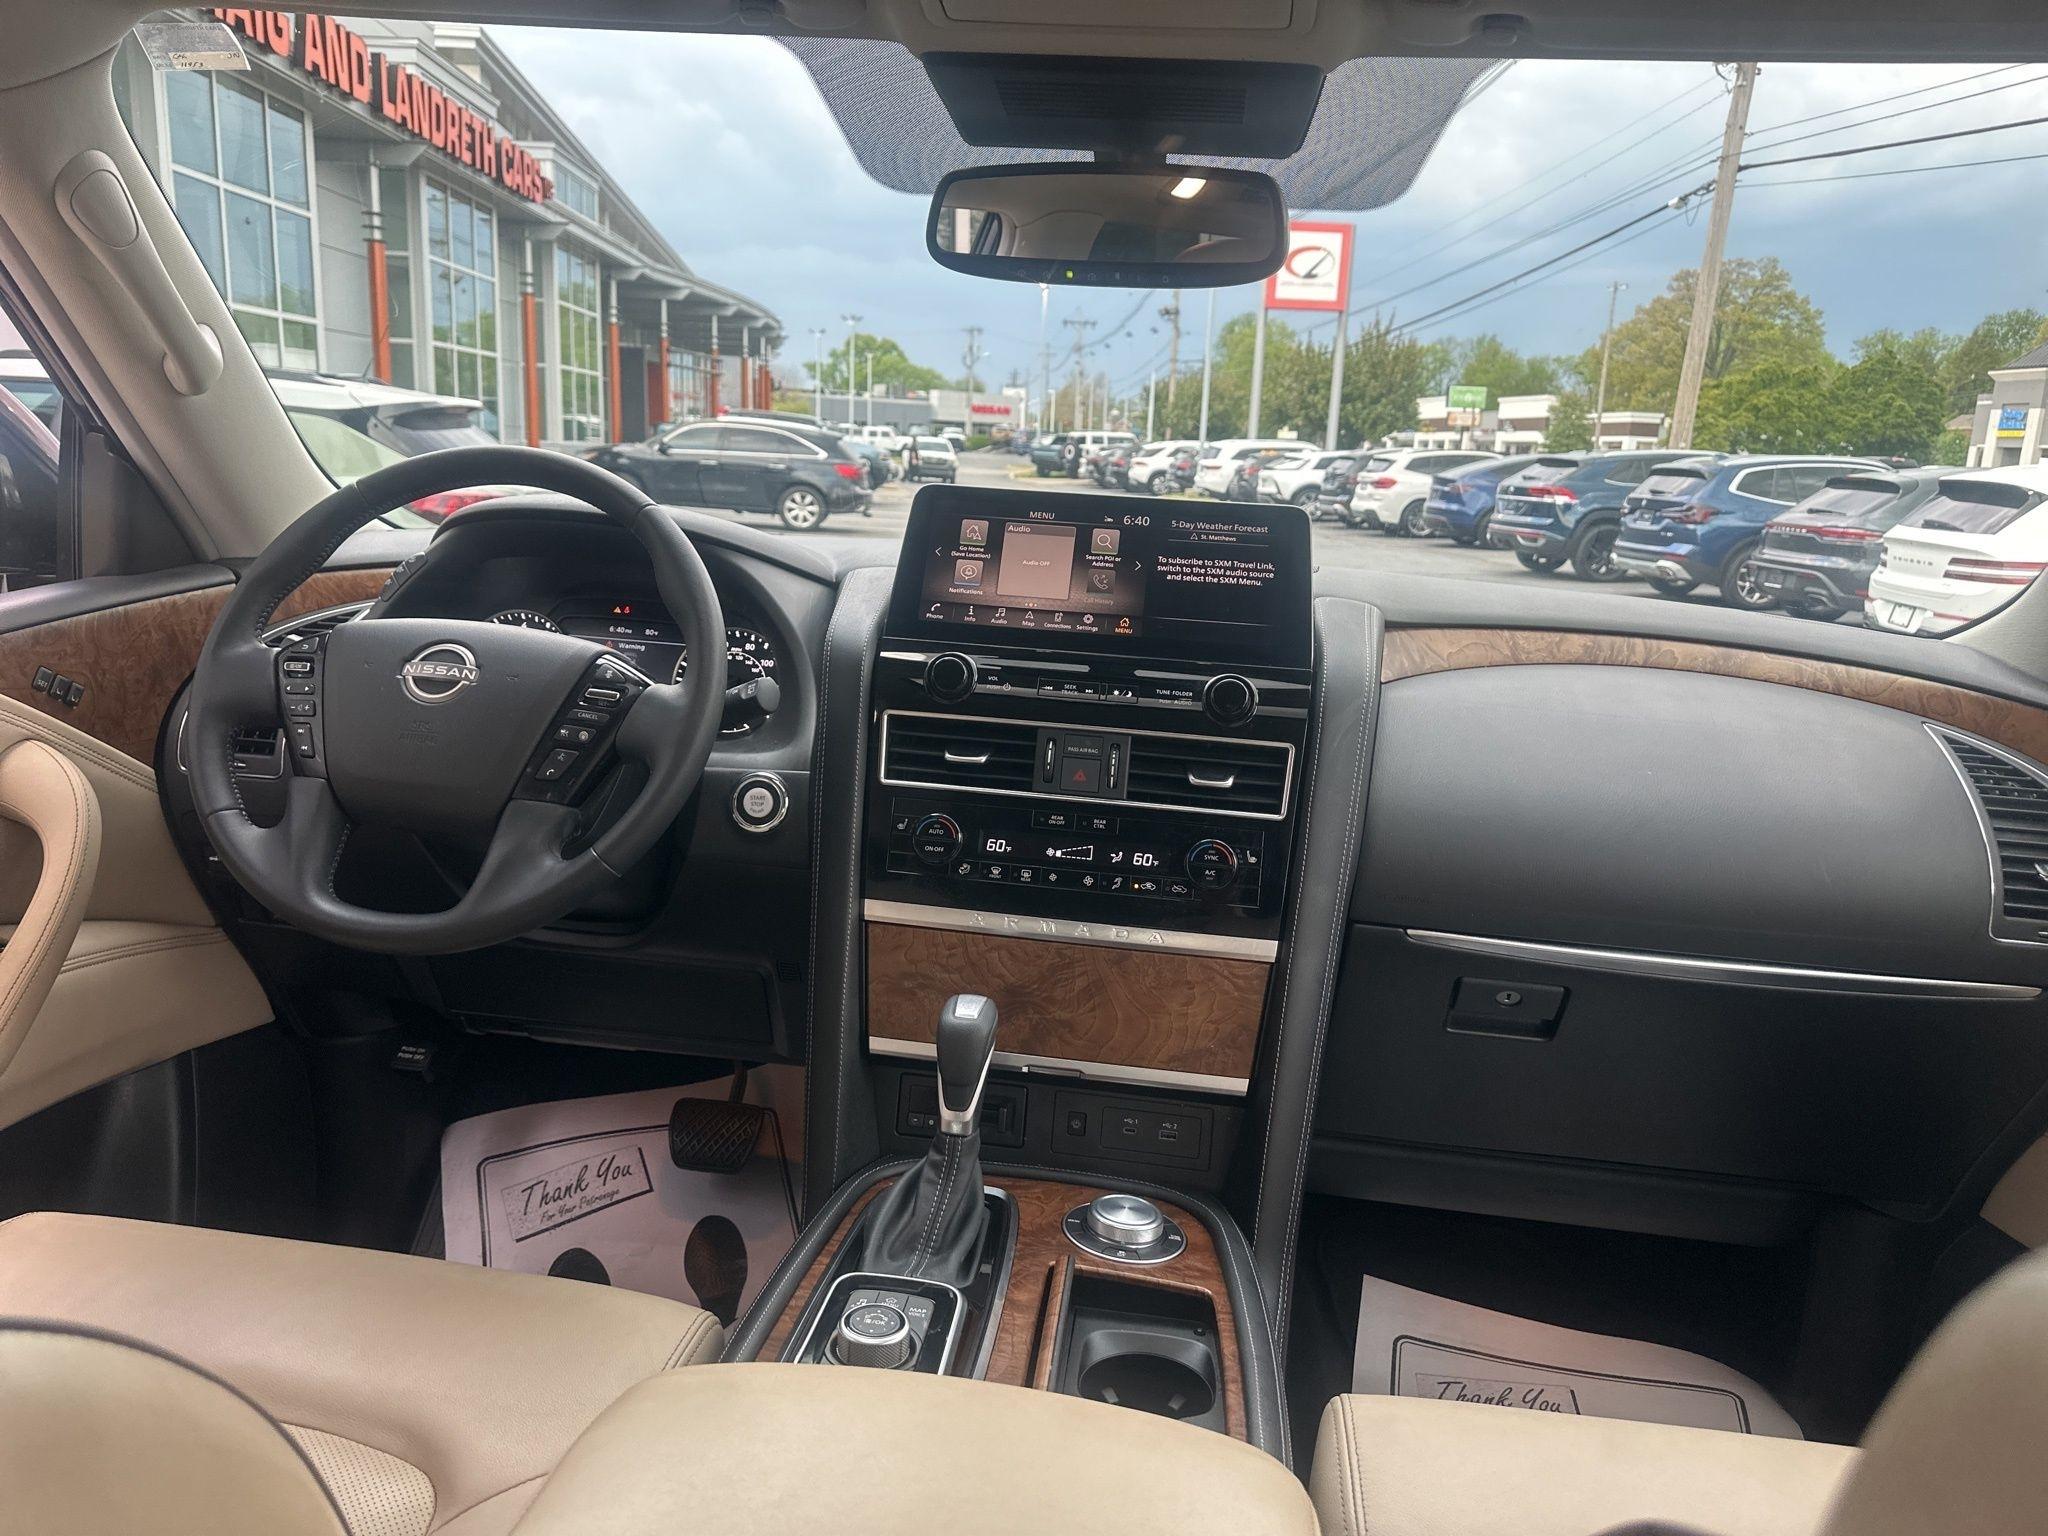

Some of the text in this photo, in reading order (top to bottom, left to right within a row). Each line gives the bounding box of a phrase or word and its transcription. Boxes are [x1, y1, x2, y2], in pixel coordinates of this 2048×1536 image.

[305, 13, 371, 104] AND
[380, 53, 496, 178] LANDRETH
[501, 136, 543, 204] CARS
[1029, 511, 1055, 520] MENU
[1123, 515, 1150, 526] 6:40
[1008, 525, 1031, 533] Audio
[1171, 520, 1269, 533] 5-Day Weather Forecast
[1210, 534, 1237, 542] Matthews
[1168, 556, 1203, 566] subscribe
[1214, 560, 1232, 568] SXM
[1233, 560, 1256, 569] Travel
[1257, 562, 1276, 571] Link,
[1157, 564, 1275, 579] switch to the SXM audio source
[1166, 573, 1263, 586] and select the SXM Menu.
[949, 587, 983, 595] Notifications
[1022, 620, 1035, 628] Map
[1044, 622, 1072, 630] Connections
[1076, 624, 1099, 632] Settings
[618, 642, 646, 652] Warning
[745, 643, 755, 651] 80
[760, 659, 774, 667] 100
[403, 664, 477, 680] NISSAN
[577, 711, 599, 720] CANCEL
[1205, 868, 1216, 876] A/C
[969, 913, 1165, 944] ARMADA
[521, 1154, 632, 1216] Thank You
[540, 1209, 555, 1224] For
[558, 1201, 577, 1216] Your
[1437, 1381, 1563, 1413] Thank You
